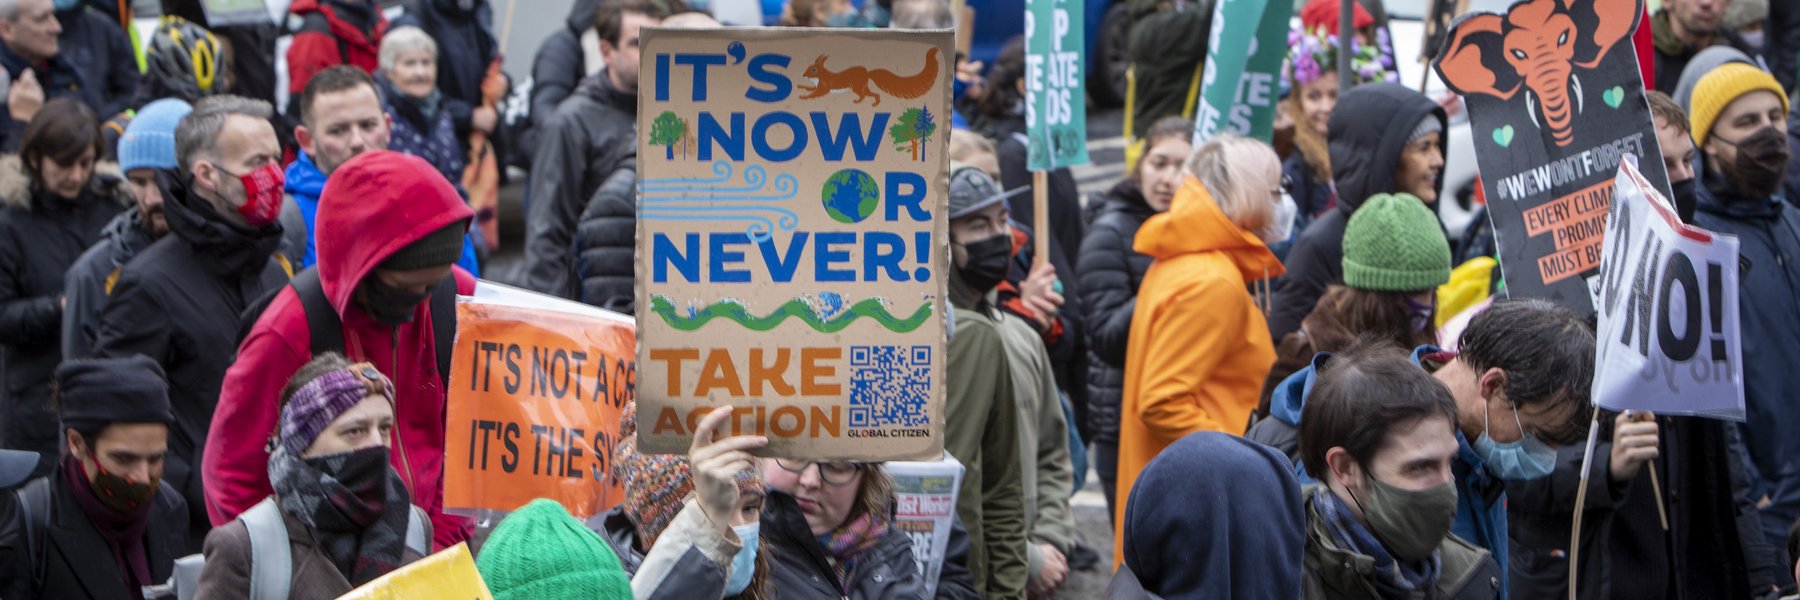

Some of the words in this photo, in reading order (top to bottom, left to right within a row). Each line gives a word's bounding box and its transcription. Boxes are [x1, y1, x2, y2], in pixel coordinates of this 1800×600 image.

[655, 41, 793, 103] IT'S
[697, 110, 892, 162] NOW
[1528, 200, 1571, 231] EVERY
[653, 231, 932, 283] NEVER!
[1542, 250, 1585, 279] MUST
[1620, 227, 1727, 362] NO!
[471, 340, 523, 395] IT'S
[530, 346, 587, 401] NOT
[593, 353, 609, 405] A
[650, 347, 842, 398] TAKE
[468, 419, 521, 474] IT'S
[530, 424, 585, 478] THE
[848, 429, 889, 438] GLOBAL
[890, 428, 930, 438] CITIZEN
